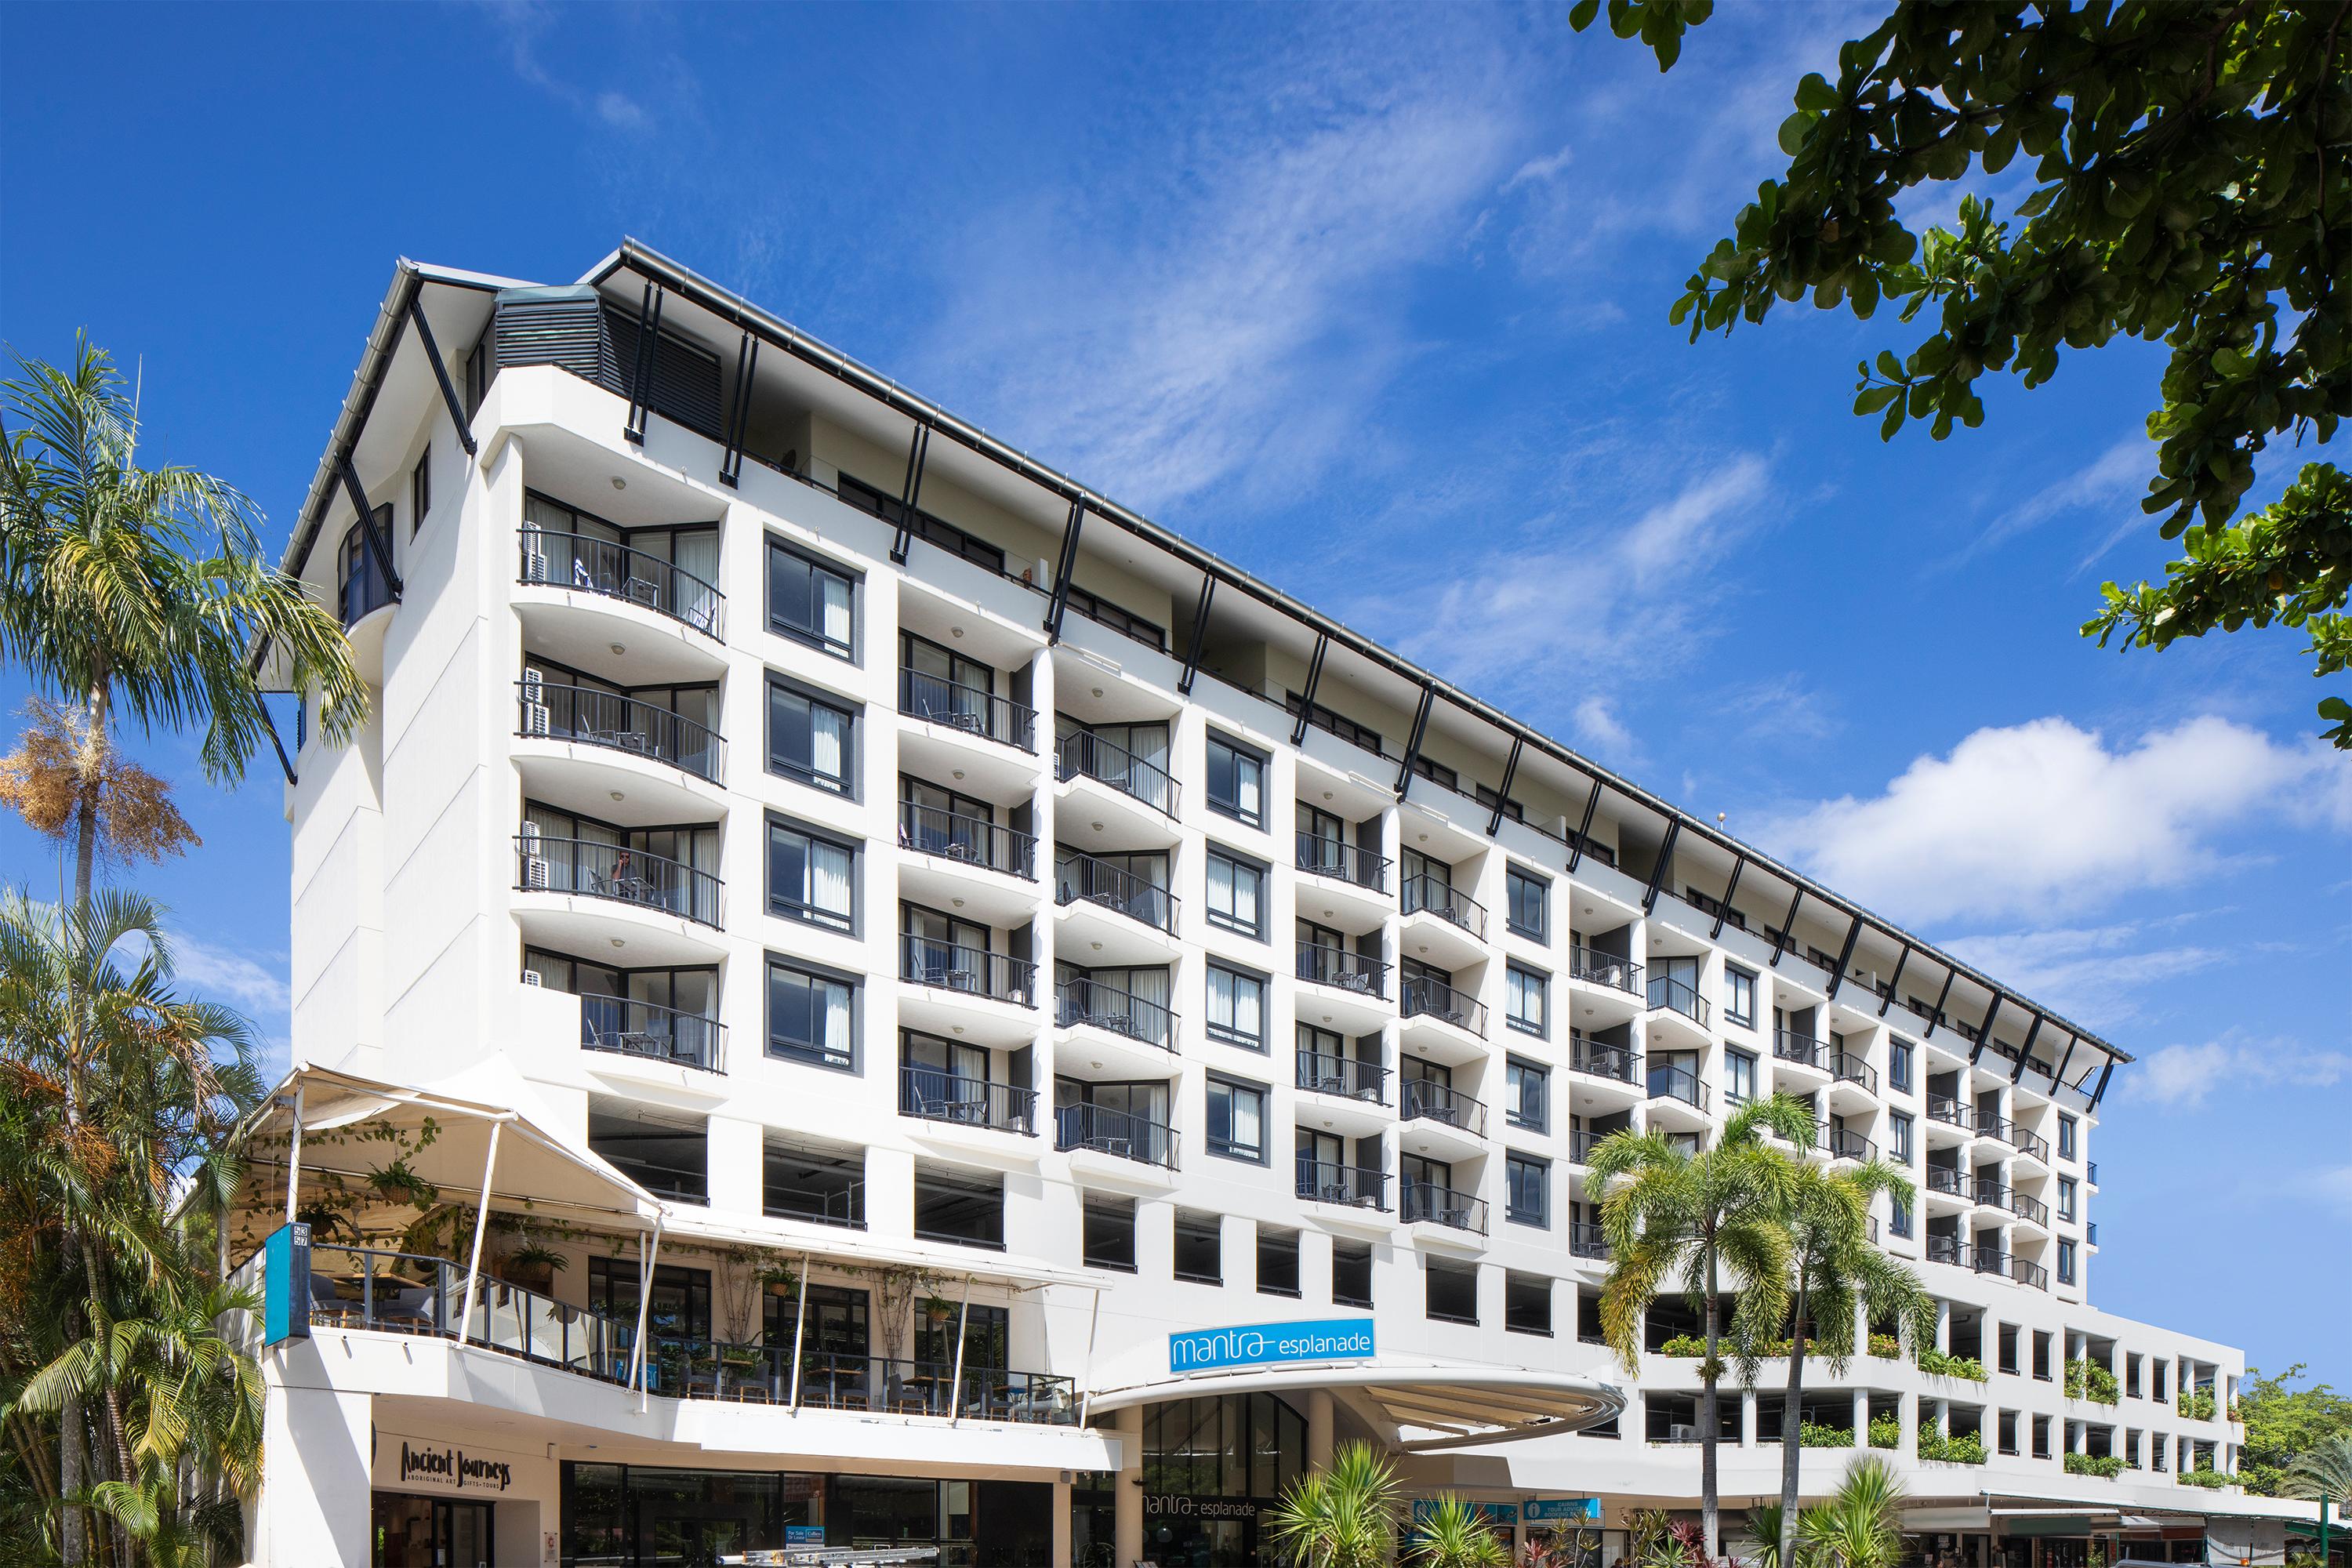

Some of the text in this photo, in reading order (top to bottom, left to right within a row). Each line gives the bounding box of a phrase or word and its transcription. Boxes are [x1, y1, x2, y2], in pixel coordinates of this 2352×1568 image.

[295, 1226, 307, 1236] 53
[295, 1236, 307, 1246] 57
[1173, 1330, 1371, 1365] mantra esplanade
[401, 1441, 511, 1491] Ancient Journeys
[407, 1474, 444, 1484] ABORIGINAL
[1200, 1501, 1255, 1518] esplanade
